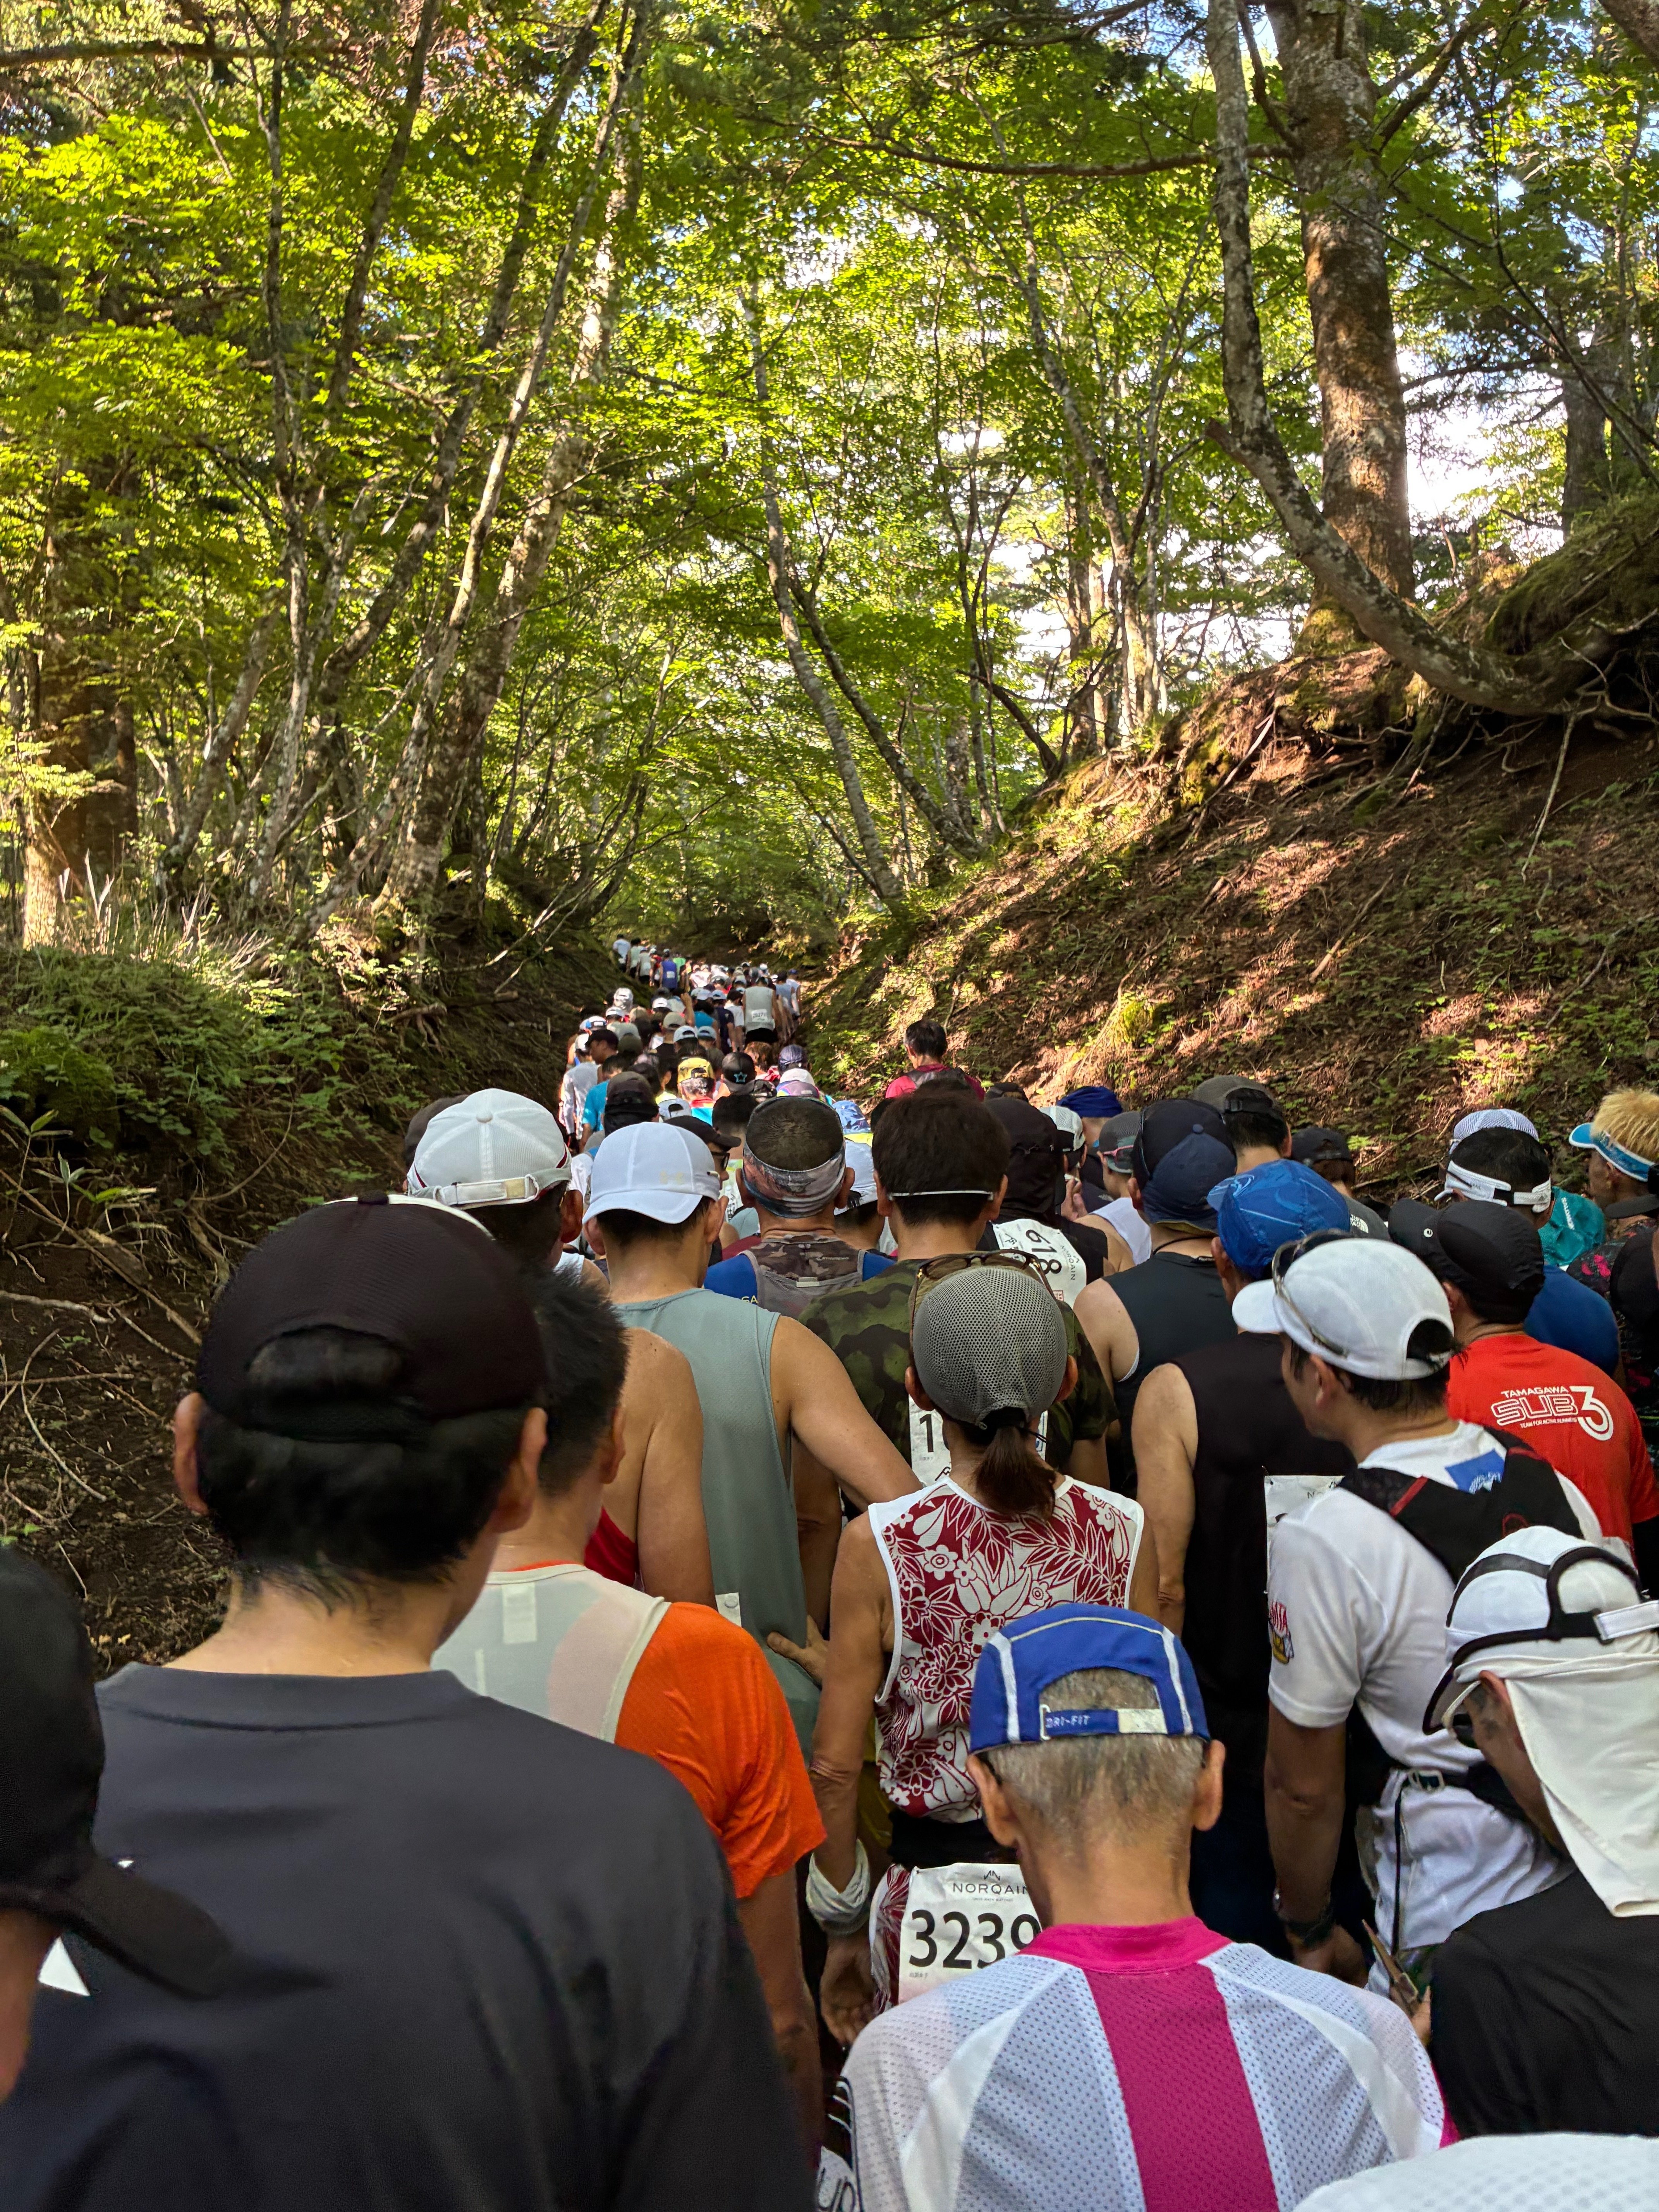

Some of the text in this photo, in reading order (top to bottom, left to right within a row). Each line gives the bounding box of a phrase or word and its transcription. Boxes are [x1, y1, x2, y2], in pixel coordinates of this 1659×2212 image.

[1025, 1229, 1062, 1274] 618
[1491, 1386, 1614, 1441] SUB 3
[1501, 1386, 1569, 1398] TAMAGAWA
